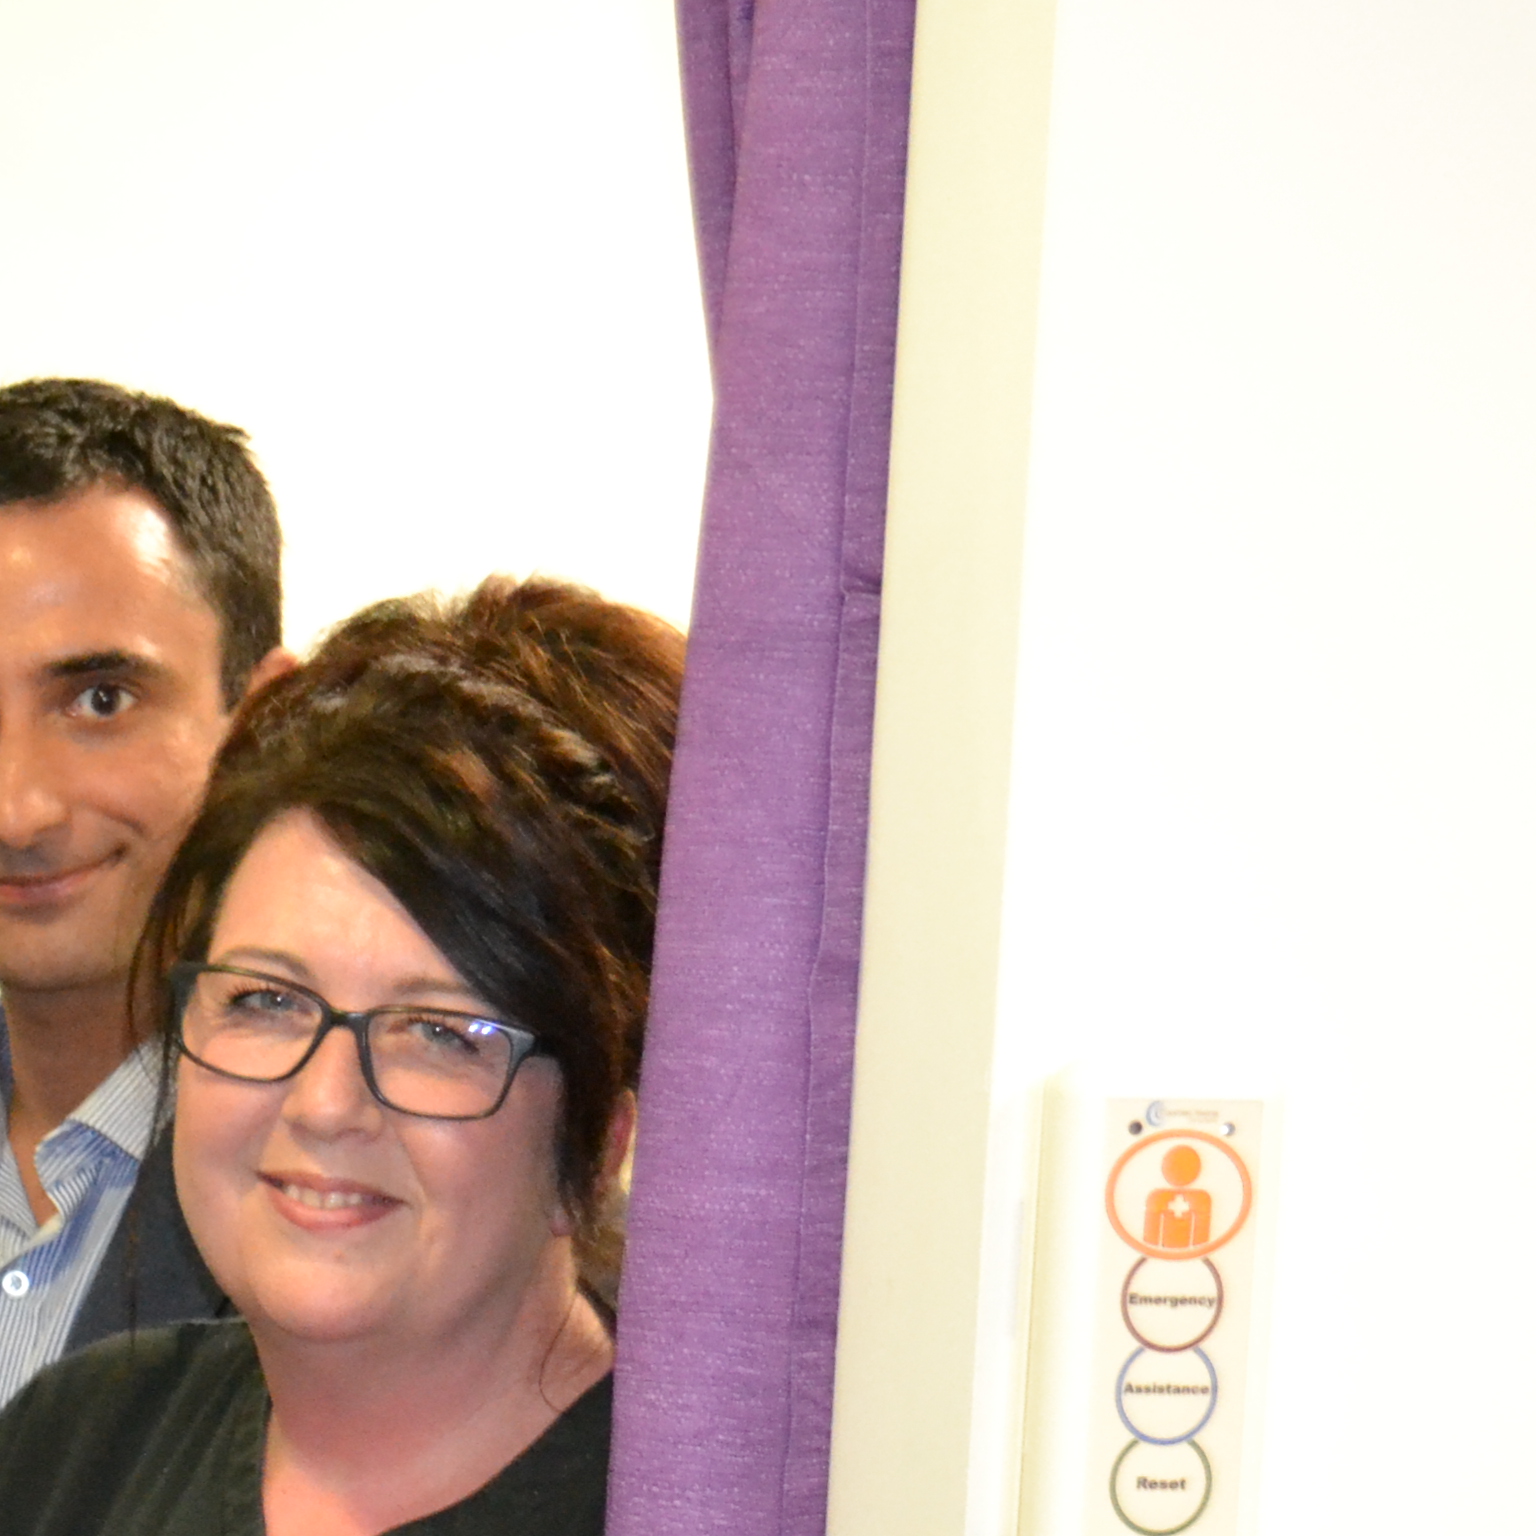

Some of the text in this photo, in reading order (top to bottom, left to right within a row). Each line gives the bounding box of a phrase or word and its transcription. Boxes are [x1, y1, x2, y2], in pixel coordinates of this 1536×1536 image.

[1128, 1292, 1217, 1309] Emergency
[1124, 1382, 1210, 1396] Assistance
[1136, 1476, 1188, 1491] Reset
